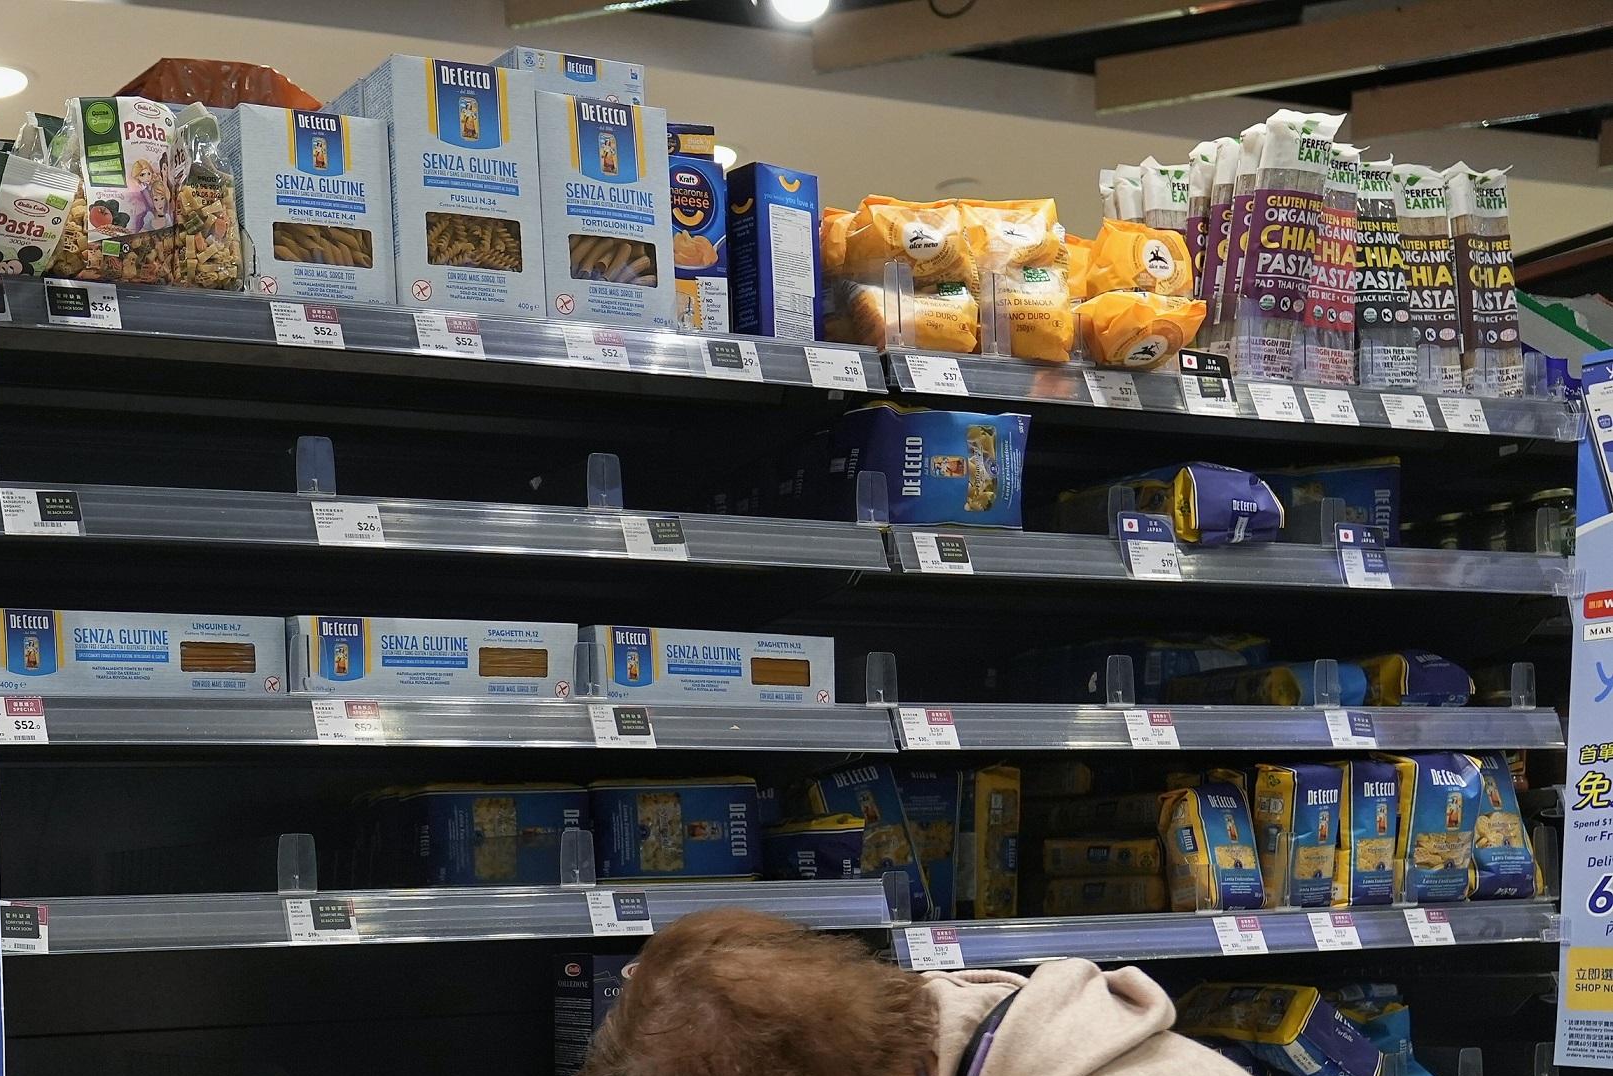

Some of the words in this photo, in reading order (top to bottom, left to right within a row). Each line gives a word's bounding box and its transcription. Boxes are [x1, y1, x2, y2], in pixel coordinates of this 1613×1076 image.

[124, 121, 167, 142] Pasta
[1301, 138, 1332, 152] PERFECT
[1298, 148, 1330, 166] EARTH
[422, 153, 464, 172] SENZA
[470, 157, 518, 178] GLUTINE
[275, 174, 314, 191] SENZA
[319, 178, 365, 197] GLUTINE
[679, 175, 695, 184] Kraft
[566, 183, 605, 201] SENZA
[609, 187, 653, 208] GLUTINE
[1405, 187, 1443, 198] PERFECT
[450, 194, 478, 204] FUSILLI
[479, 197, 497, 206] N.34
[1267, 196, 1307, 209] GLUTEN
[1405, 197, 1445, 210] EARTH
[289, 208, 313, 217] PENNE
[315, 210, 340, 219] RIGATE
[342, 212, 356, 221] N.41
[581, 219, 627, 230] TORTIGLIONI
[629, 223, 644, 233] N.23
[1260, 225, 1315, 252] CHIA
[1255, 279, 1274, 288] PAD
[1278, 280, 1295, 290] THAI
[192, 622, 227, 631] LINGUINE
[73, 628, 115, 644] SENZA
[119, 629, 169, 646] GLUTINE
[488, 629, 524, 638] SPAGHETTI
[381, 635, 418, 650] SENZA
[423, 636, 469, 652] GLUTINE
[15, 720, 41, 730] $52.0
[1572, 770, 1611, 810] 免
[1573, 819, 1600, 829] Spend
[1585, 833, 1597, 842] for
[1576, 983, 1601, 992] SHOP
